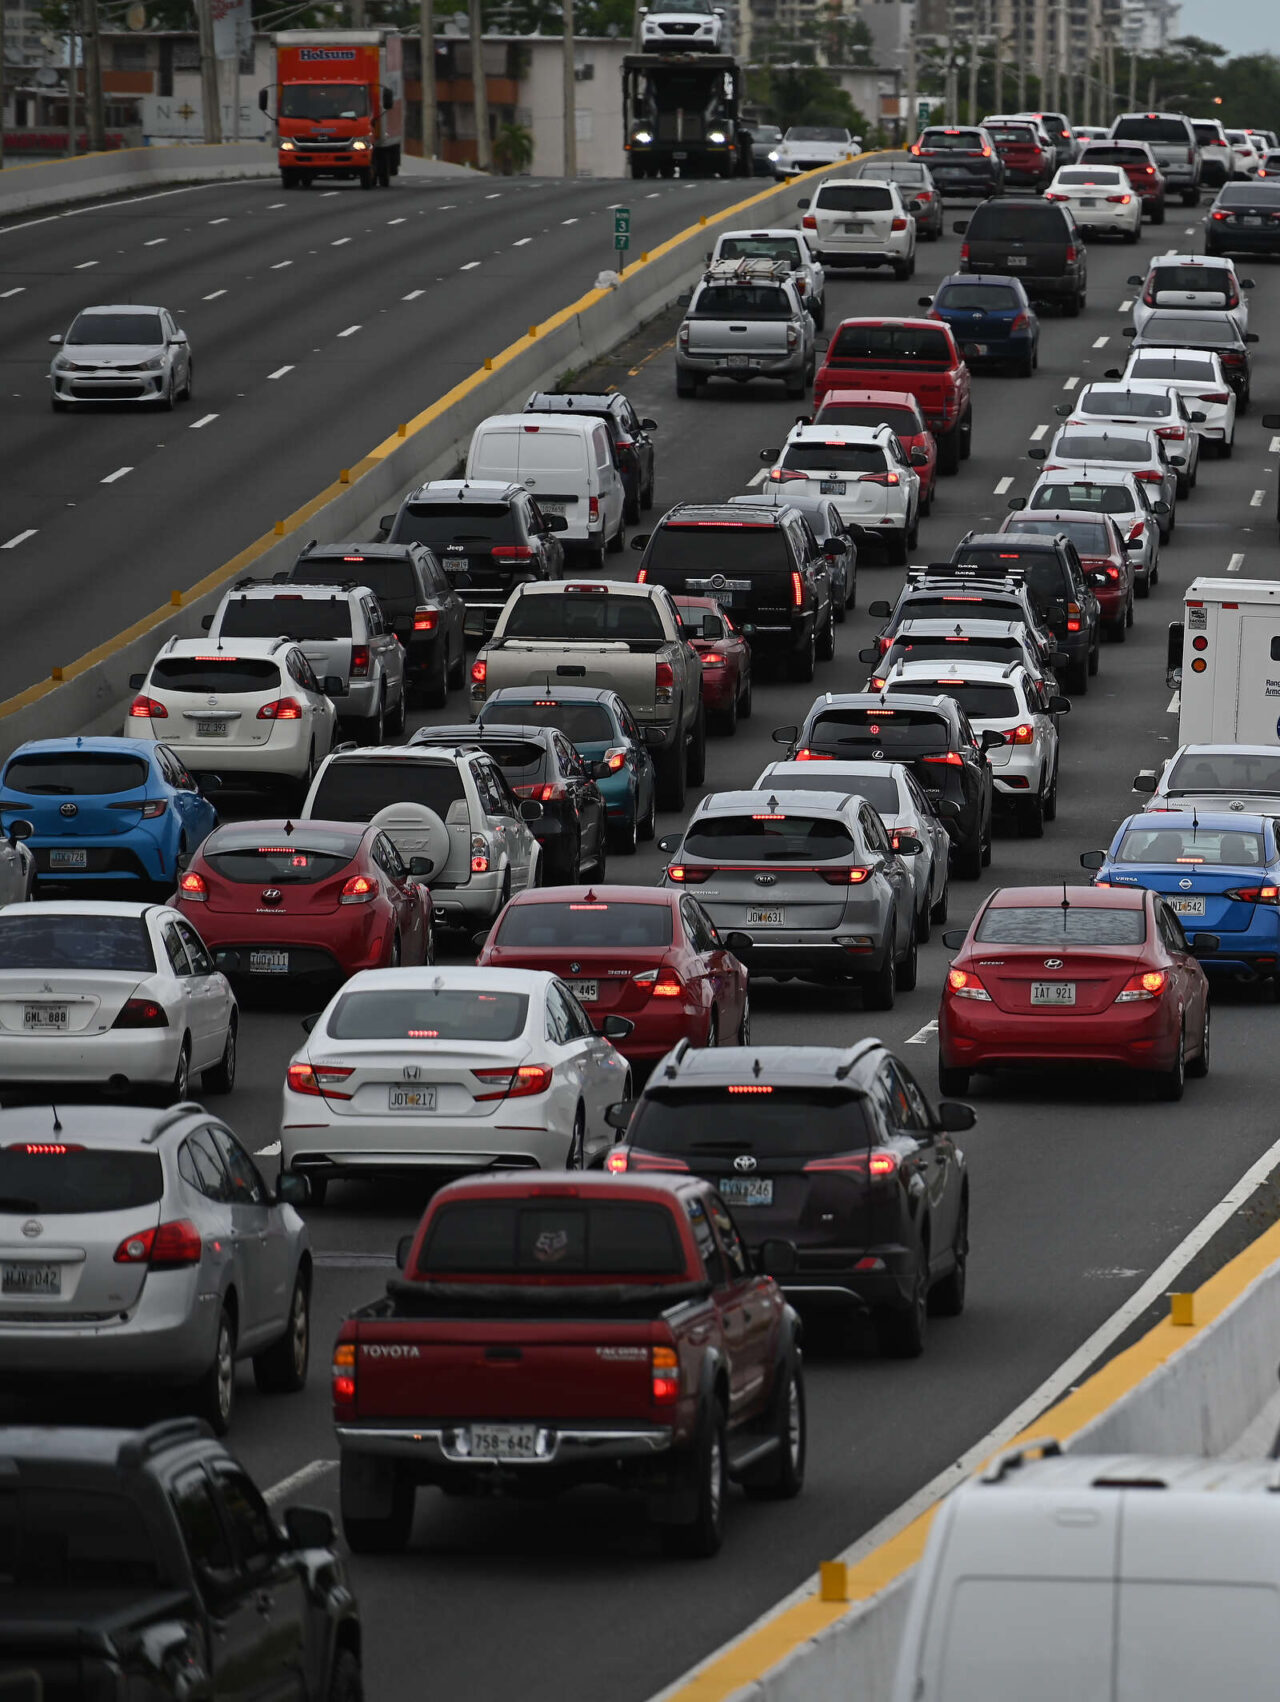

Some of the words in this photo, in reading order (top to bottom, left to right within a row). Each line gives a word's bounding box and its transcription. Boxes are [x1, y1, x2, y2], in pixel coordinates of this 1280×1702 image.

[300, 50, 357, 61] Holsum
[619, 221, 627, 232] 3
[619, 237, 626, 249] 7
[446, 544, 465, 552] Jeep
[1186, 901, 1202, 911] 542
[767, 912, 782, 923] 631
[580, 985, 596, 995] 445
[1034, 985, 1051, 998] IAT
[1055, 986, 1073, 999] 921
[391, 1093, 408, 1105] JOT
[415, 1093, 434, 1105] 217
[361, 1344, 421, 1358] TOYOTA
